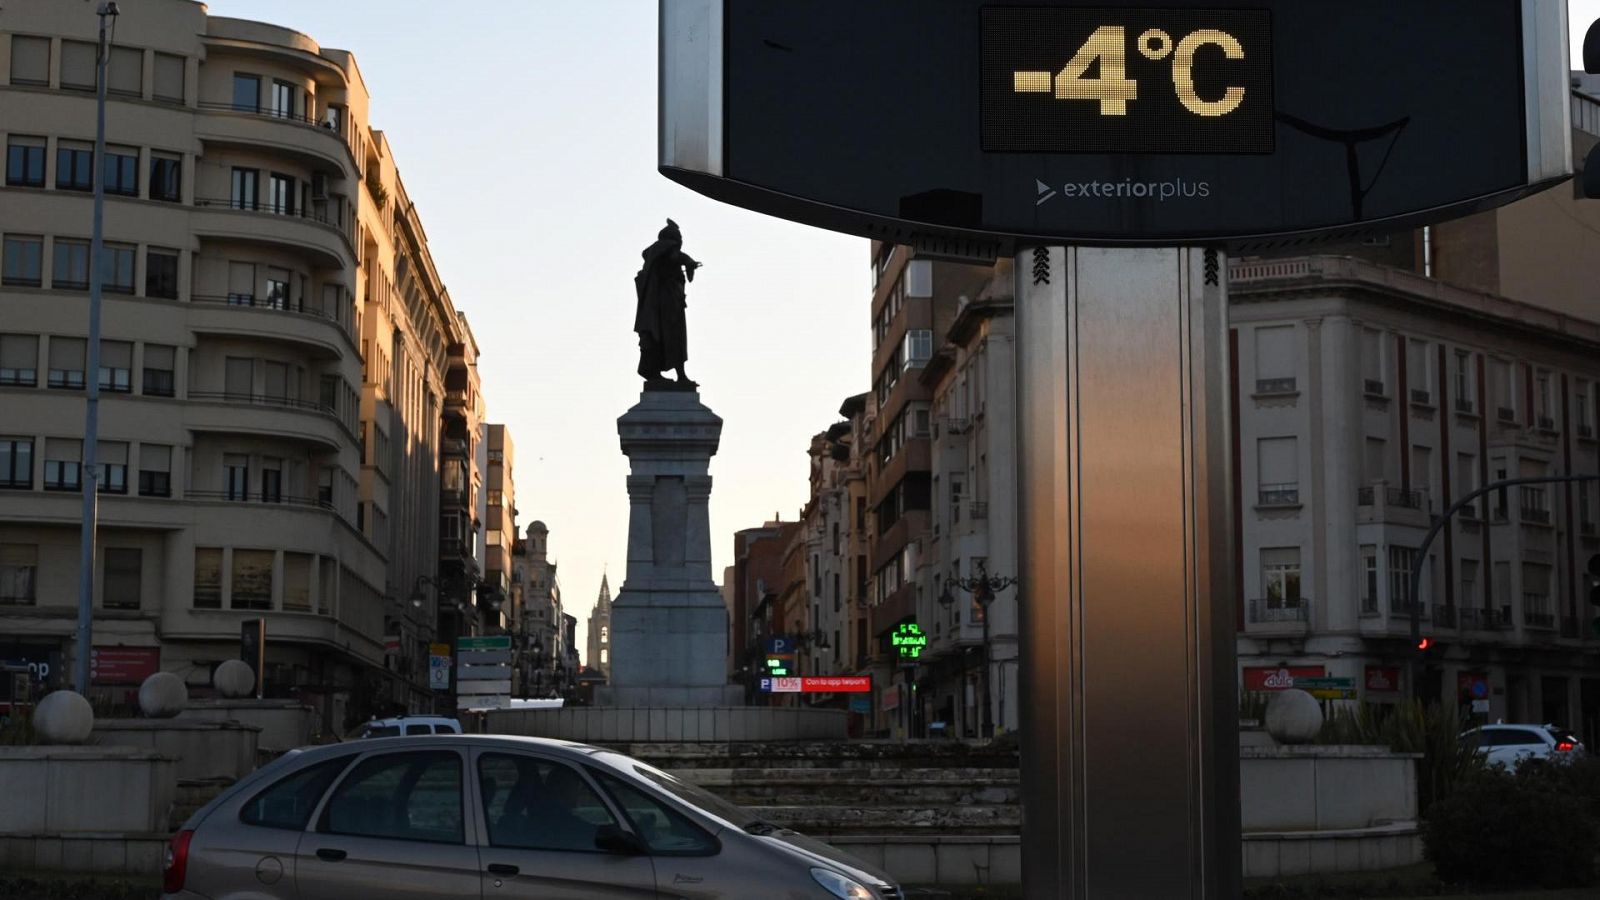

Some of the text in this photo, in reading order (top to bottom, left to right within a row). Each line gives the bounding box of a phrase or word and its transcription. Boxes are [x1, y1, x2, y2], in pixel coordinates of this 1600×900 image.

[1014, 25, 1246, 117] -4°C
[1063, 177, 1210, 201] exteriorplus
[775, 639, 785, 653] P
[761, 679, 769, 689] P
[777, 678, 798, 688] 10%
